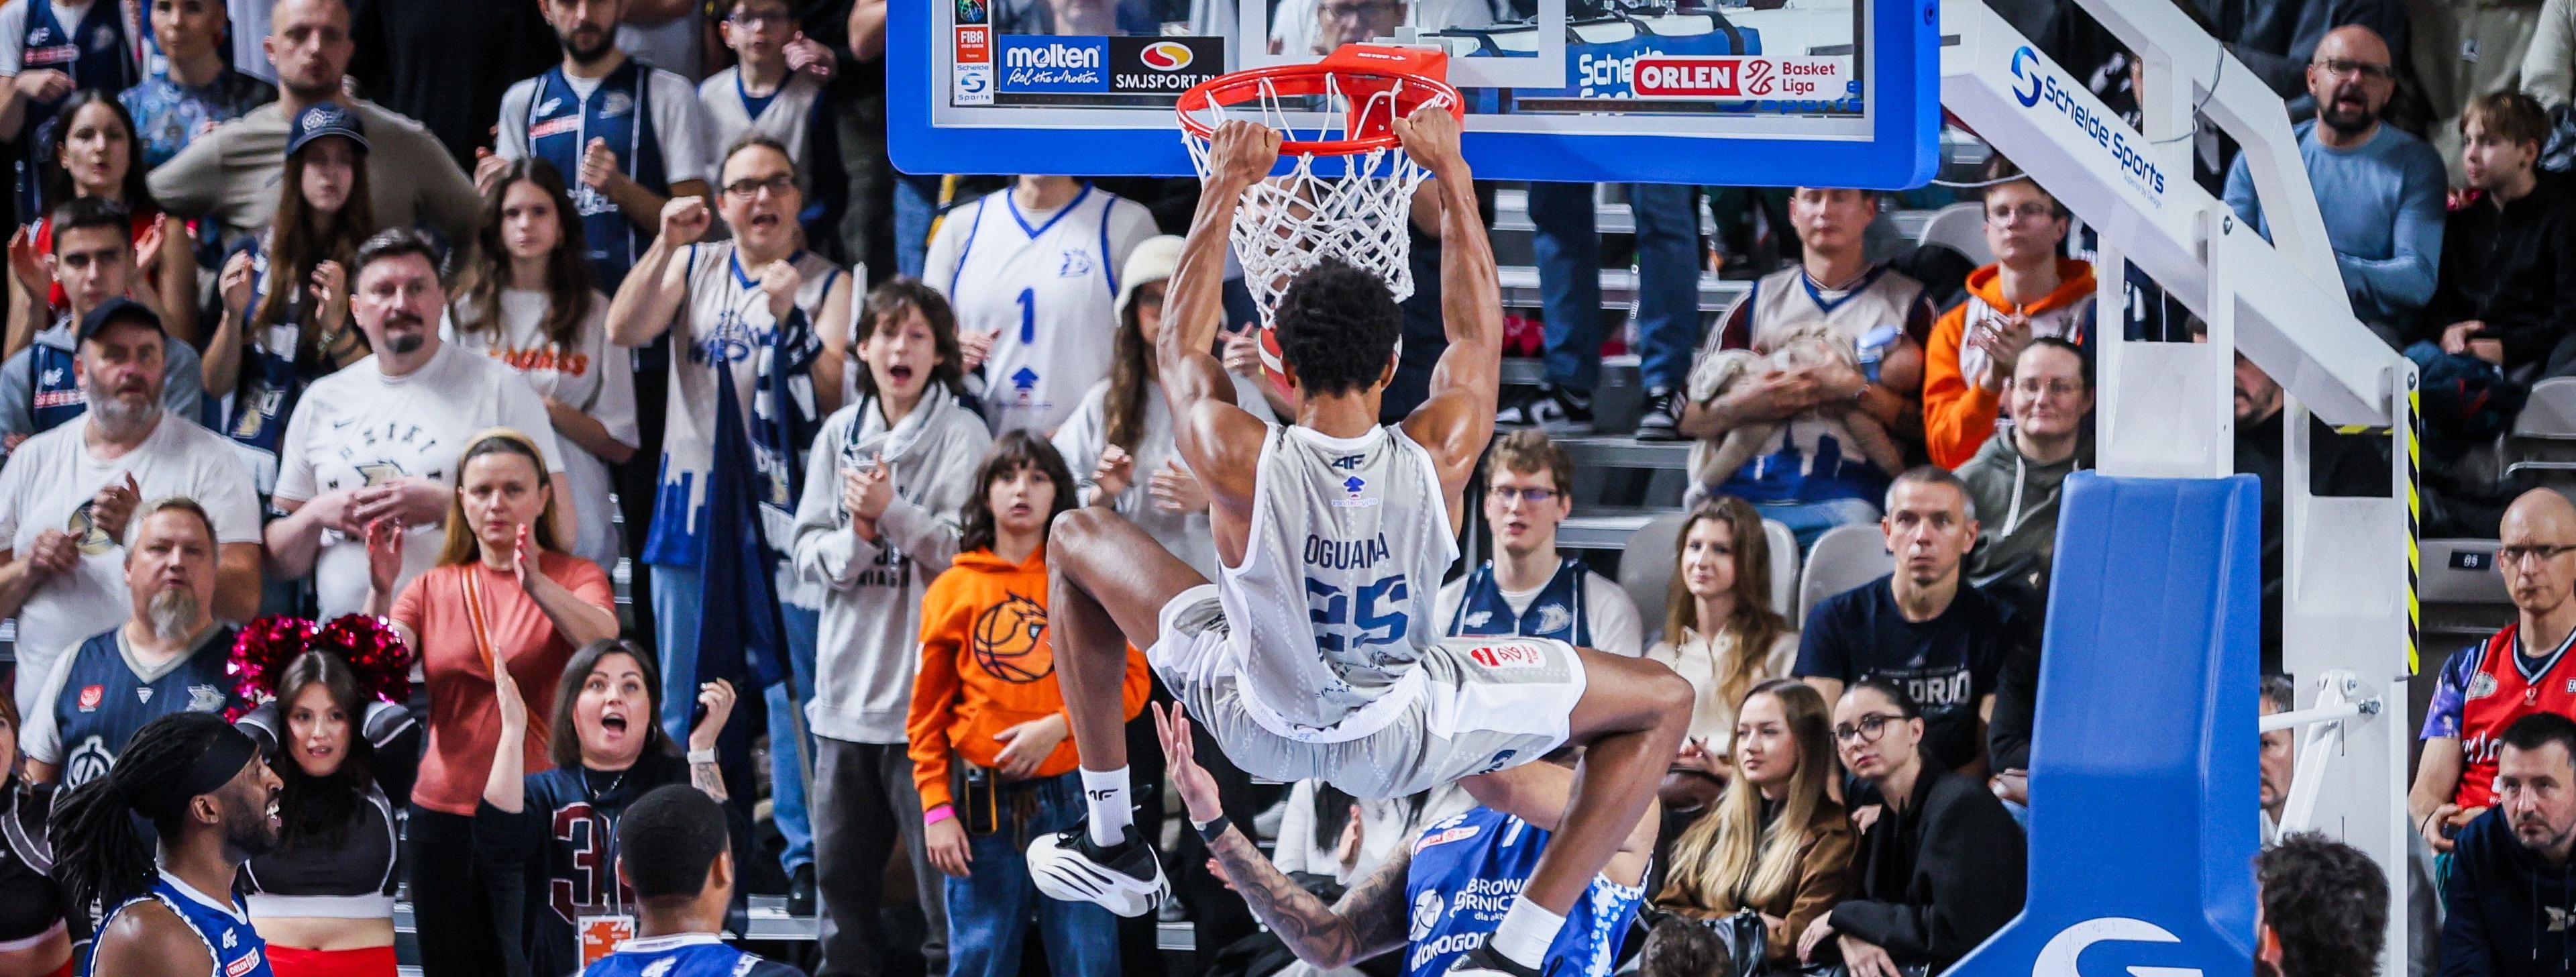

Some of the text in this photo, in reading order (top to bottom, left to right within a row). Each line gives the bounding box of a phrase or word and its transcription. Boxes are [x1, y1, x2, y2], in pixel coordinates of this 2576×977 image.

[961, 30, 984, 44] FIBA
[1007, 44, 1099, 68] molten
[1579, 46, 1664, 87] Sche
[1007, 68, 1034, 86] feel
[1032, 71, 1053, 83] the
[1641, 66, 1730, 89] ORLEN
[1782, 62, 1835, 75] Basket
[1782, 79, 1815, 95] Liga
[2044, 75, 2165, 195] Schelde Sports
[1017, 287, 1034, 344] 1
[1332, 454, 1366, 470] 4F
[1305, 574, 1409, 654] 25
[1908, 670, 1972, 705] DRID
[1474, 913, 1489, 921] dla
[223, 927, 237, 949] 4F
